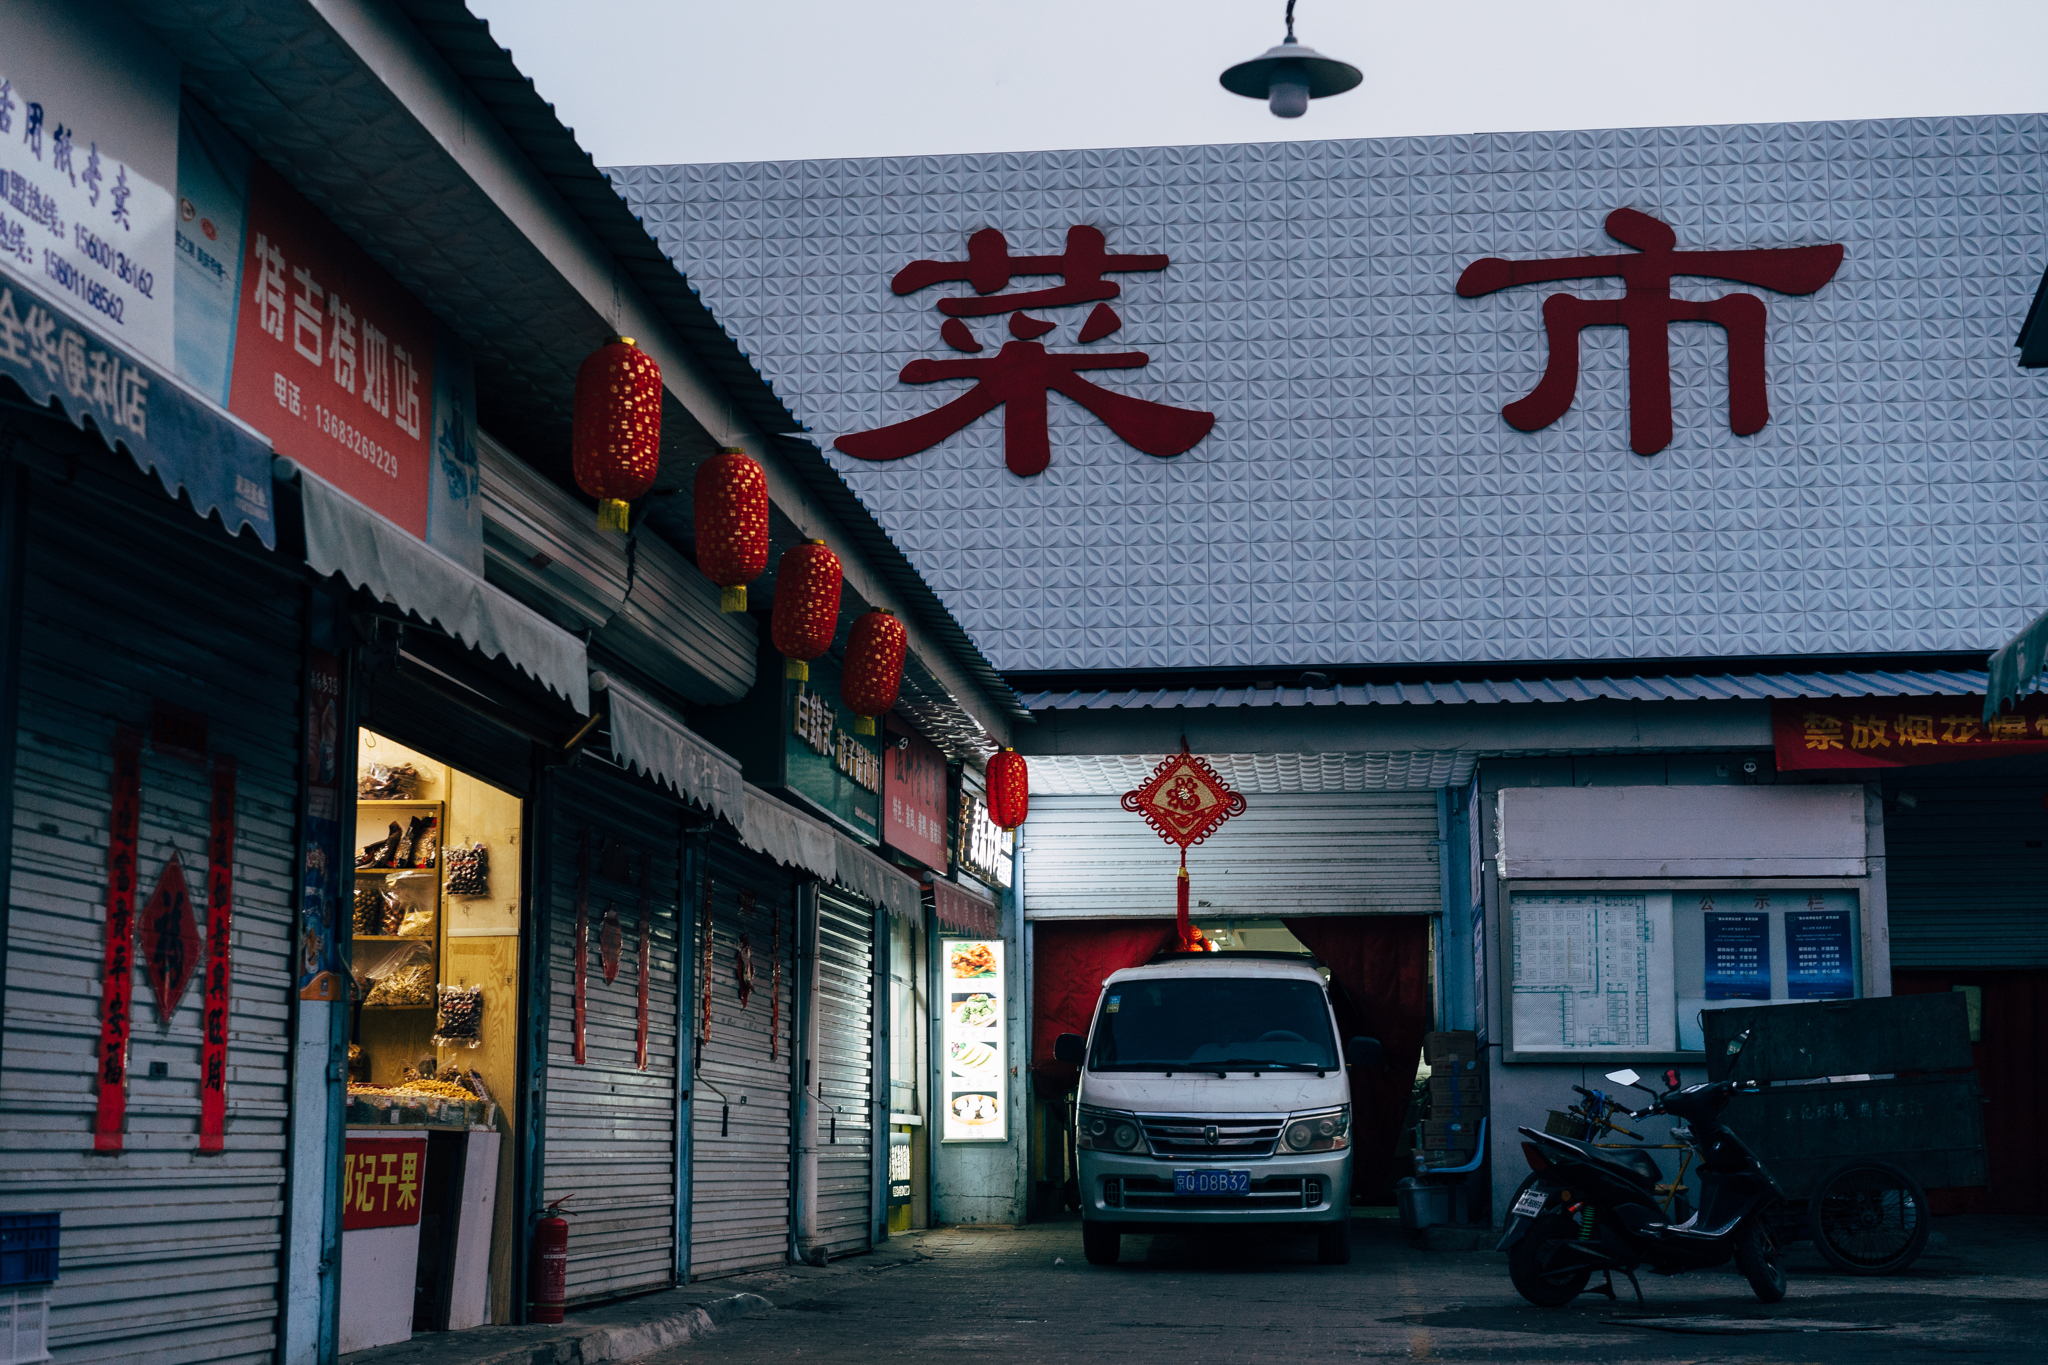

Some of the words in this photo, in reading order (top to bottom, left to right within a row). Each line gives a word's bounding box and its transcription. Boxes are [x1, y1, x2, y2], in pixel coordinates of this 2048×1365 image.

[255, 232, 420, 440] 特吉特奶站
[316, 403, 398, 479] 13683269229
[154, 889, 184, 990] 福
